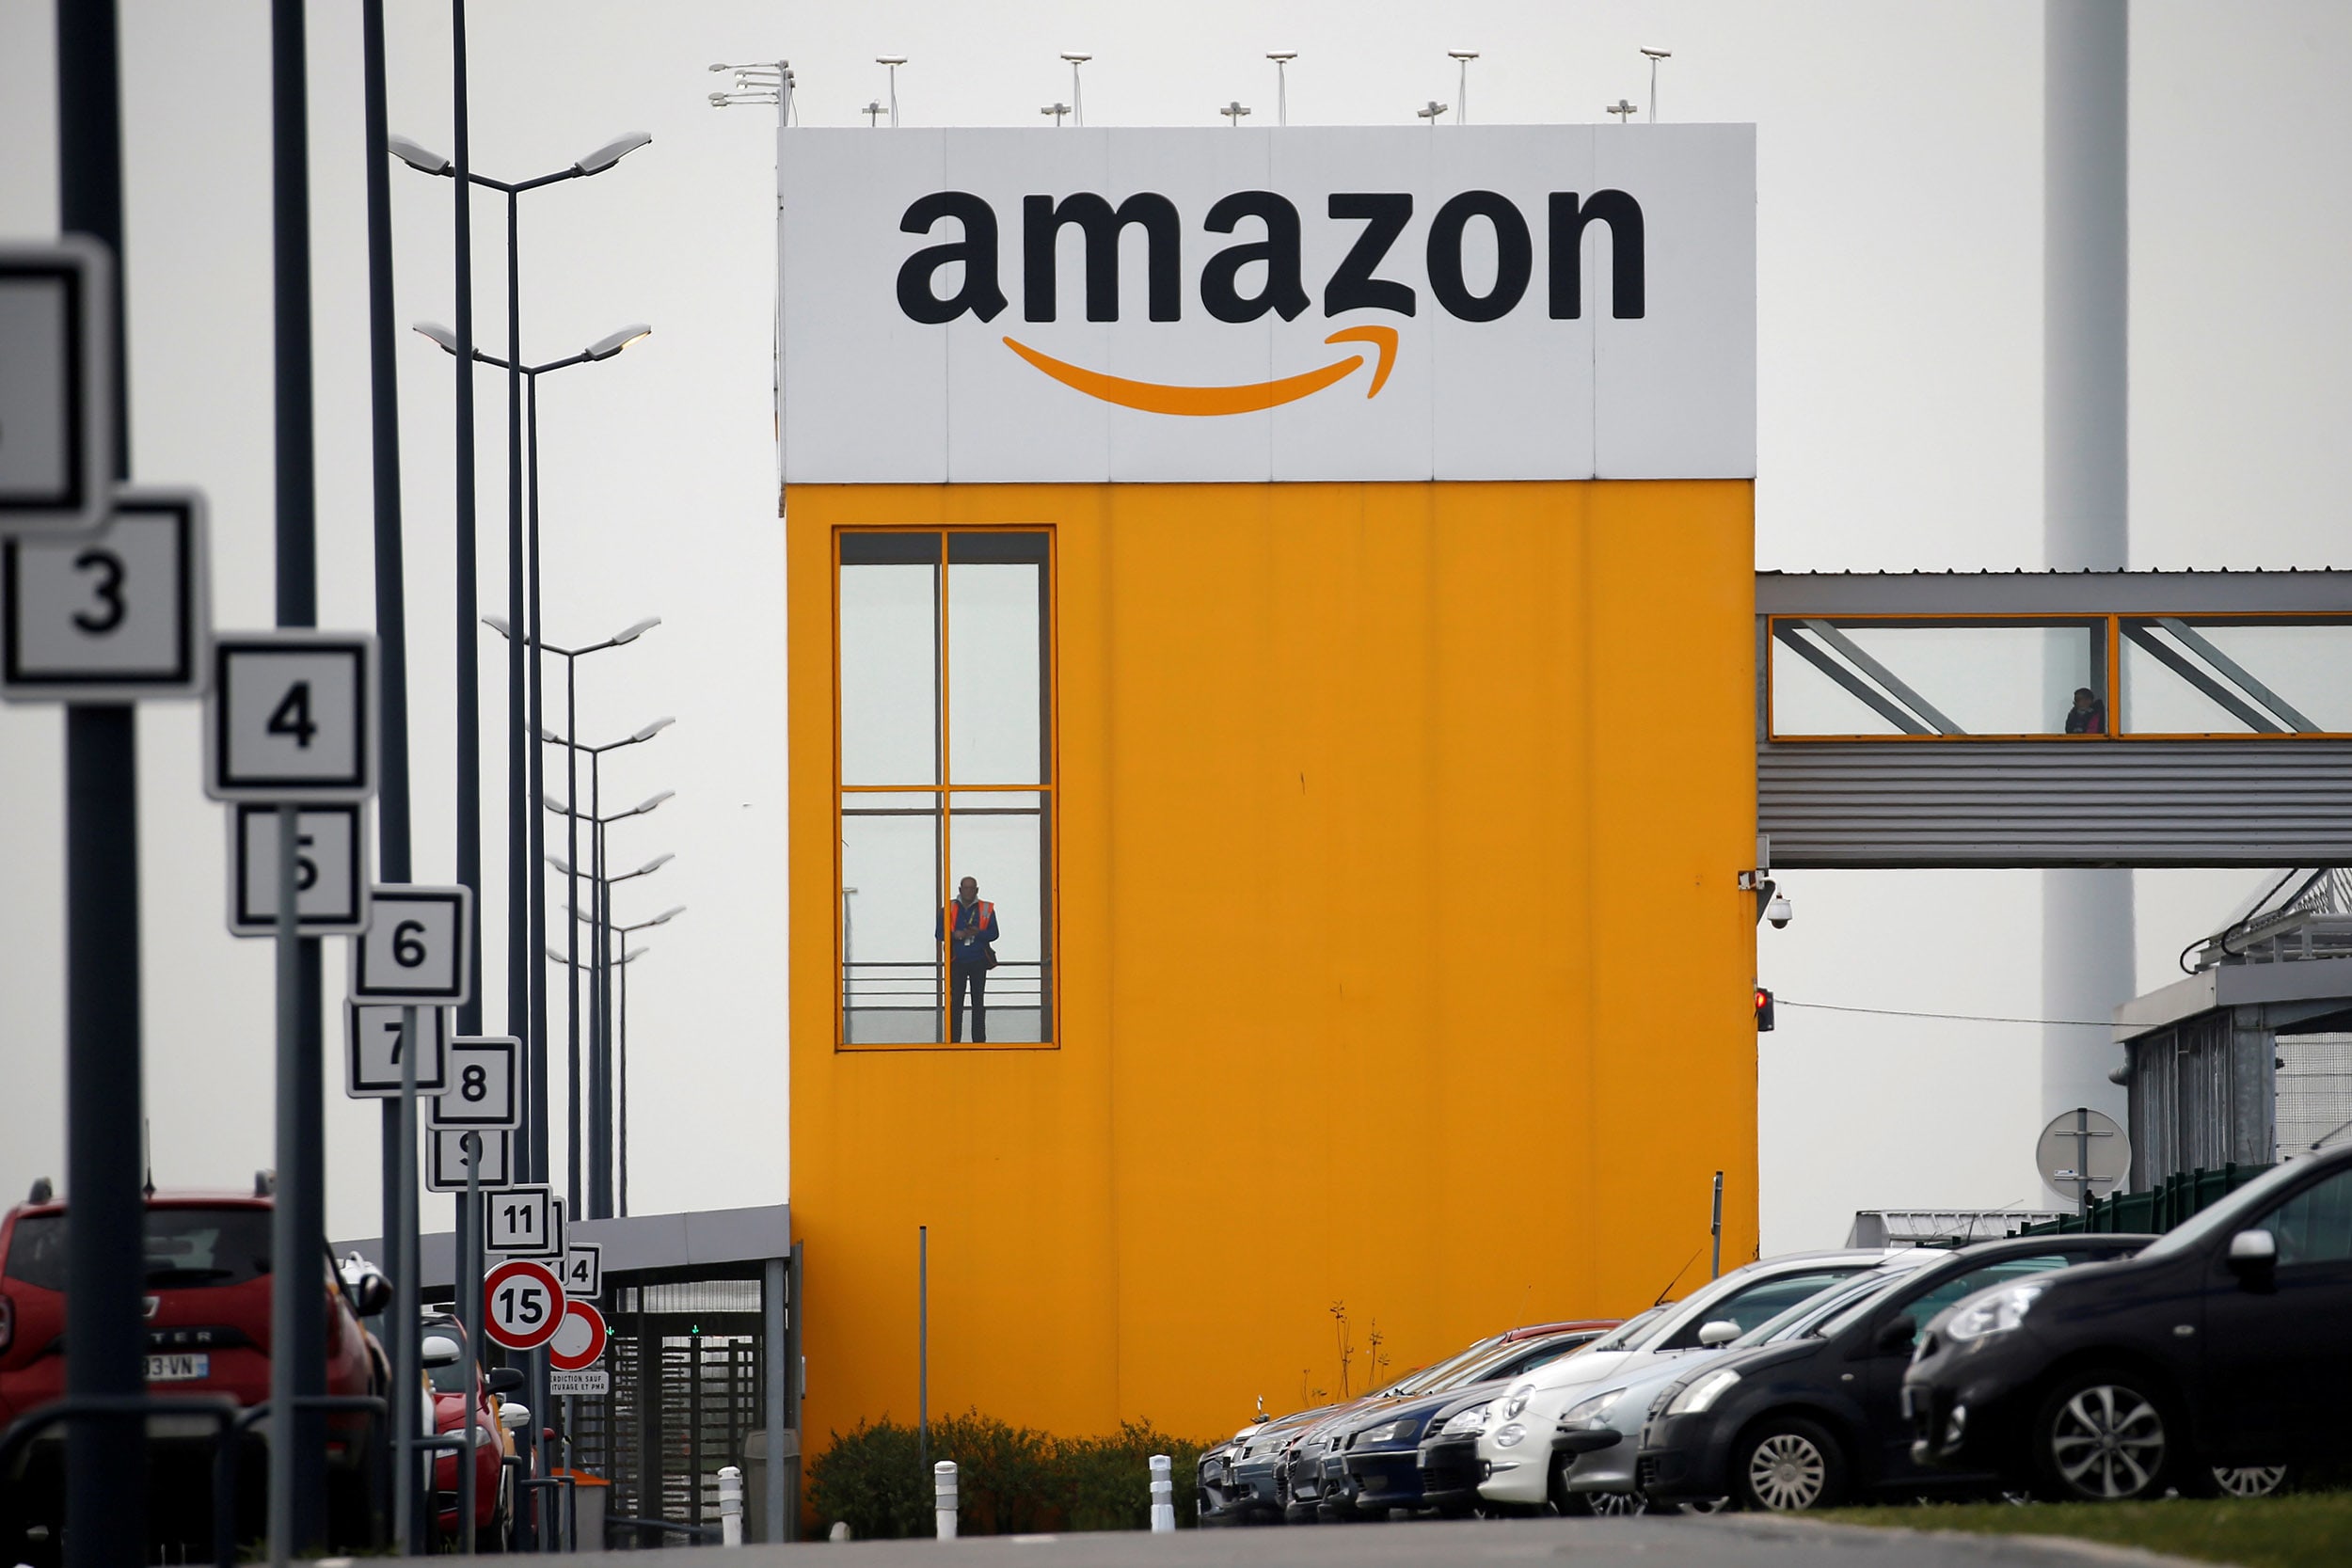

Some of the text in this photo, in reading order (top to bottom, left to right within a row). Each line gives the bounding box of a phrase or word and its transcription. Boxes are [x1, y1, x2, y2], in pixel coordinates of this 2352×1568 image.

[897, 189, 1645, 325] amazon
[71, 546, 127, 637] 3
[265, 679, 317, 750] 4
[392, 920, 427, 969] 6
[384, 1022, 404, 1065] 7
[461, 1064, 487, 1102] 8
[459, 1132, 484, 1166] 9
[503, 1204, 532, 1235] 11
[499, 1287, 544, 1324] 15
[150, 1331, 213, 1344] TER
